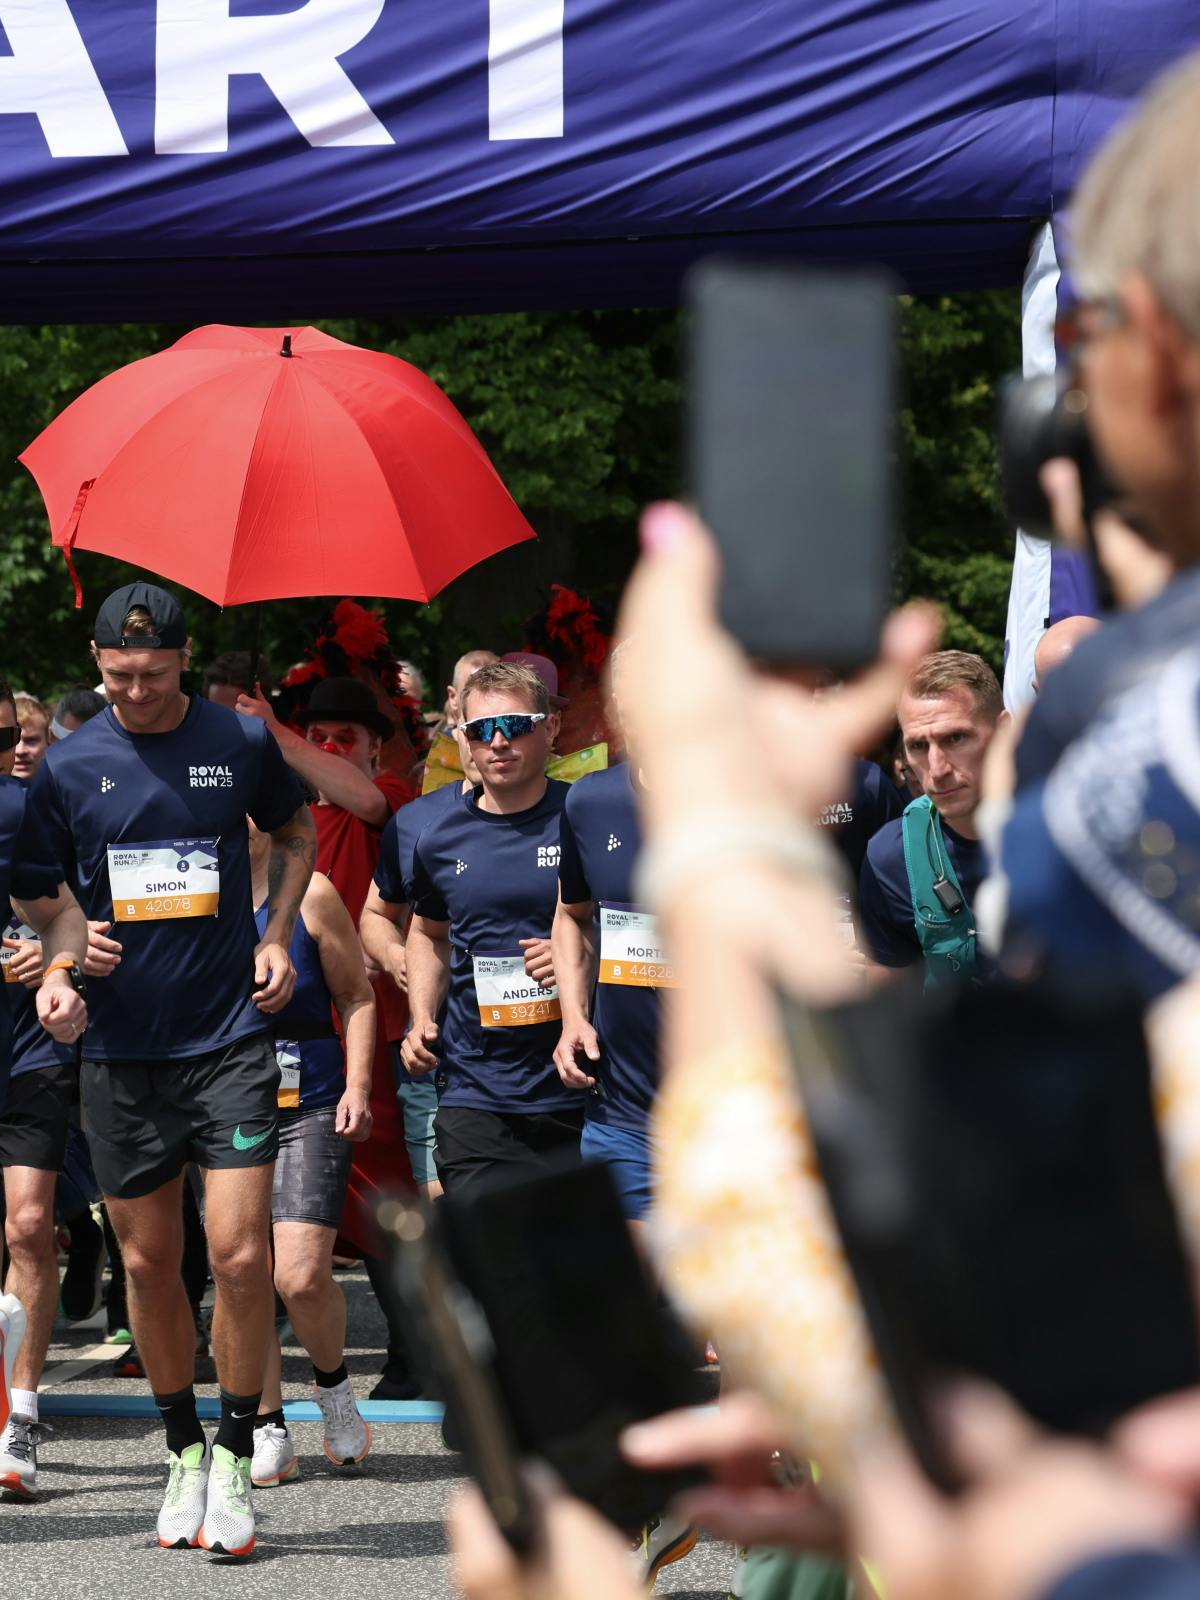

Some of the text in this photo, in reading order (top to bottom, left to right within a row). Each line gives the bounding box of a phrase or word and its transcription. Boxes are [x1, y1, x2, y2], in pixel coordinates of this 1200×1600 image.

[188, 765, 233, 776] ROYAL
[820, 802, 853, 815] OYAL
[145, 881, 187, 893] SIMON
[127, 905, 136, 915] B
[145, 897, 191, 912] 42078
[627, 947, 665, 959] MORT
[613, 965, 621, 976] B
[503, 988, 553, 1000] ANDERS
[492, 1010, 500, 1020] B
[511, 1003, 550, 1019] 39241
